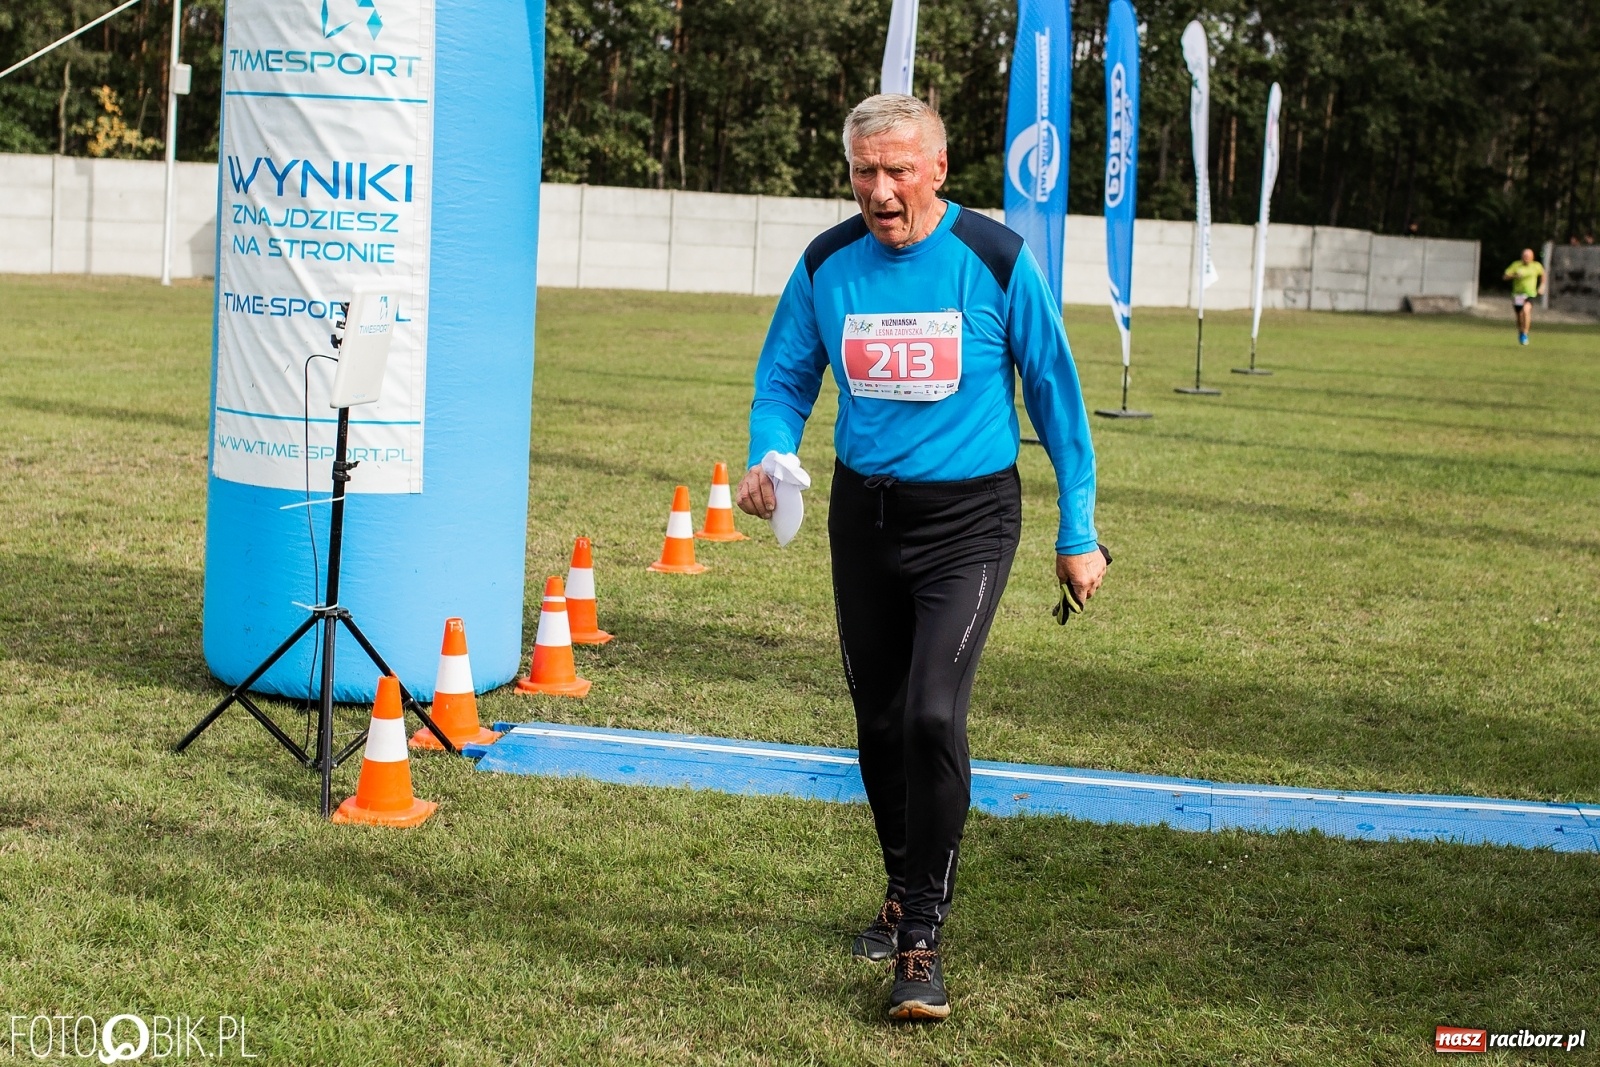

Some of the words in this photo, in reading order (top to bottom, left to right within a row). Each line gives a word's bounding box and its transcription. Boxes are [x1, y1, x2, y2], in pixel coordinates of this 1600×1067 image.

[230, 49, 421, 77] TIMESPORT
[228, 155, 412, 203] WYNIKI
[232, 204, 399, 233] ZNAJDZIESZ
[233, 235, 261, 256] NA
[268, 237, 395, 263] STRONIE
[895, 327, 924, 336] ZADYSZKA
[865, 342, 935, 378] 213
